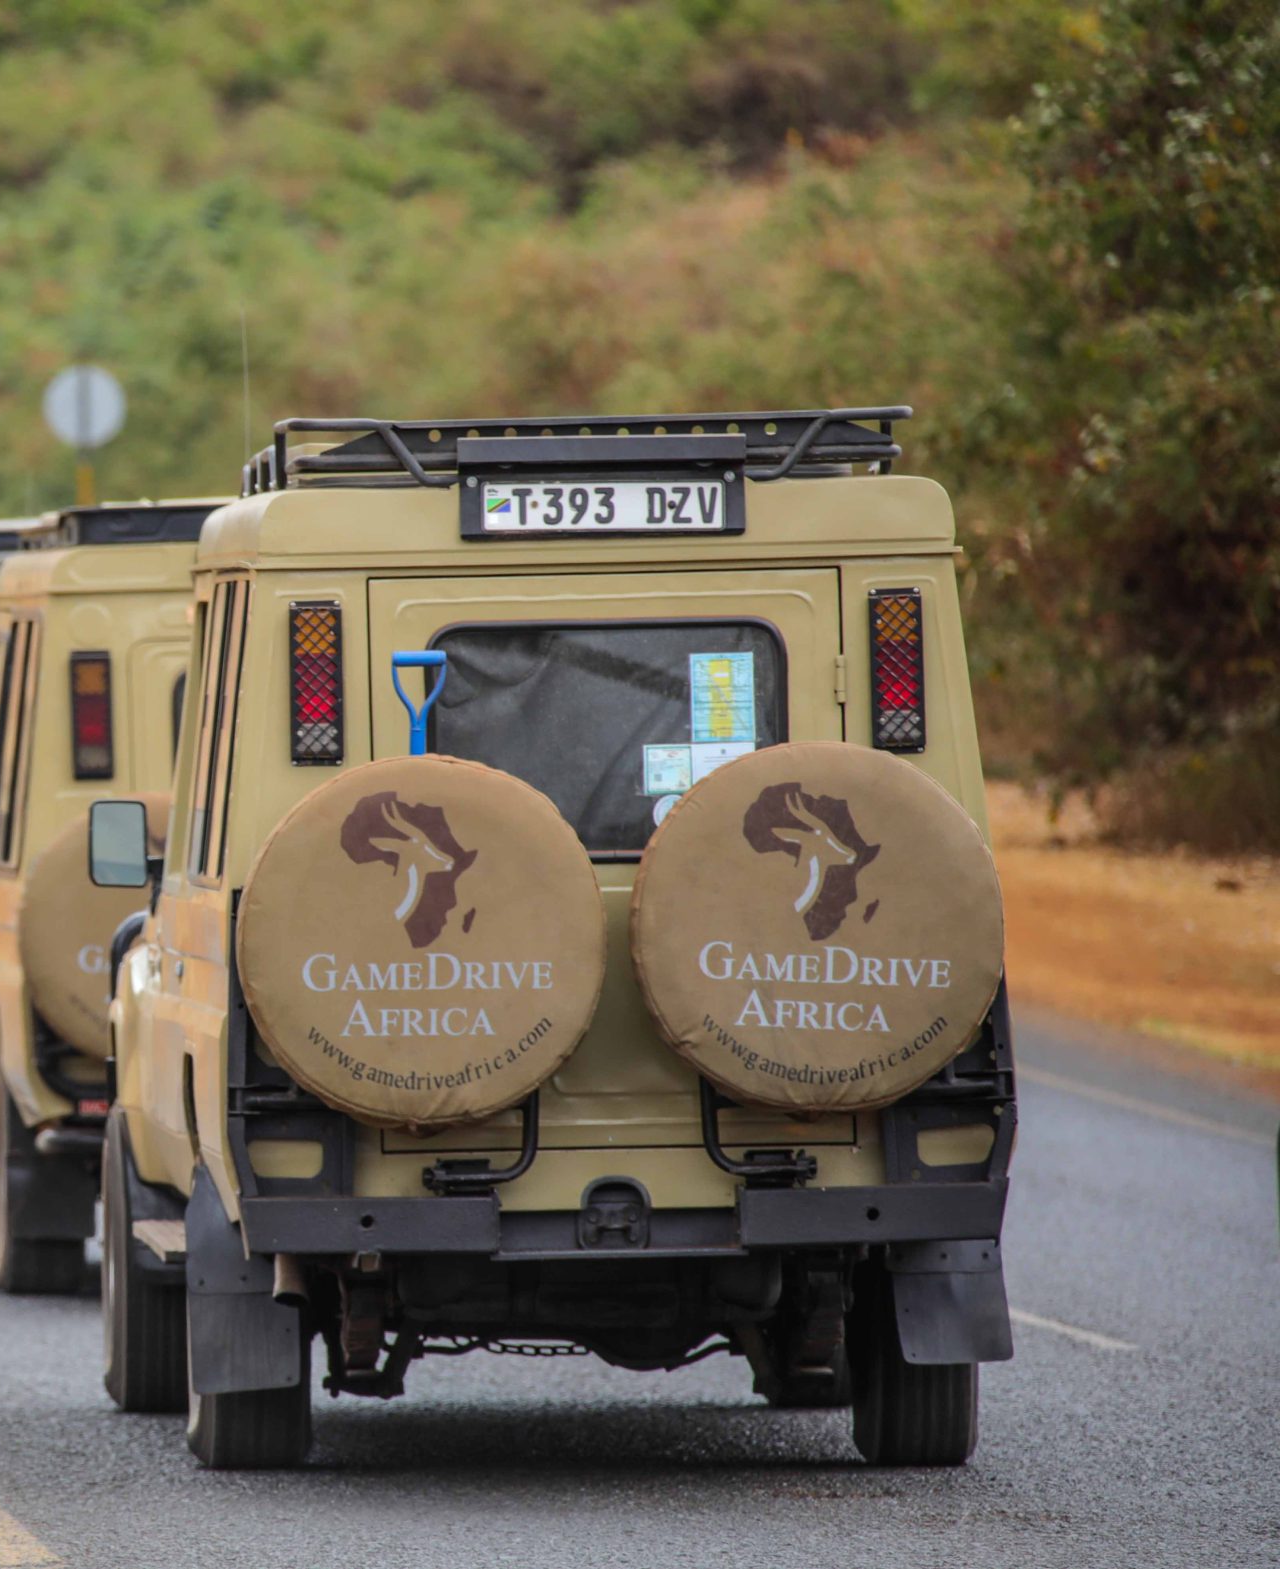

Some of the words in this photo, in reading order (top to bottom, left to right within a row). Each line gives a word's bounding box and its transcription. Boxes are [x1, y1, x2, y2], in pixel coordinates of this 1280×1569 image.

[646, 486, 718, 524] DZV
[340, 999, 496, 1037] AFRICA
[734, 989, 890, 1032] AFRICA
[307, 1016, 553, 1091] www.gamedriveafrica.com
[701, 1013, 949, 1085] www.gamedriveafrica.com
